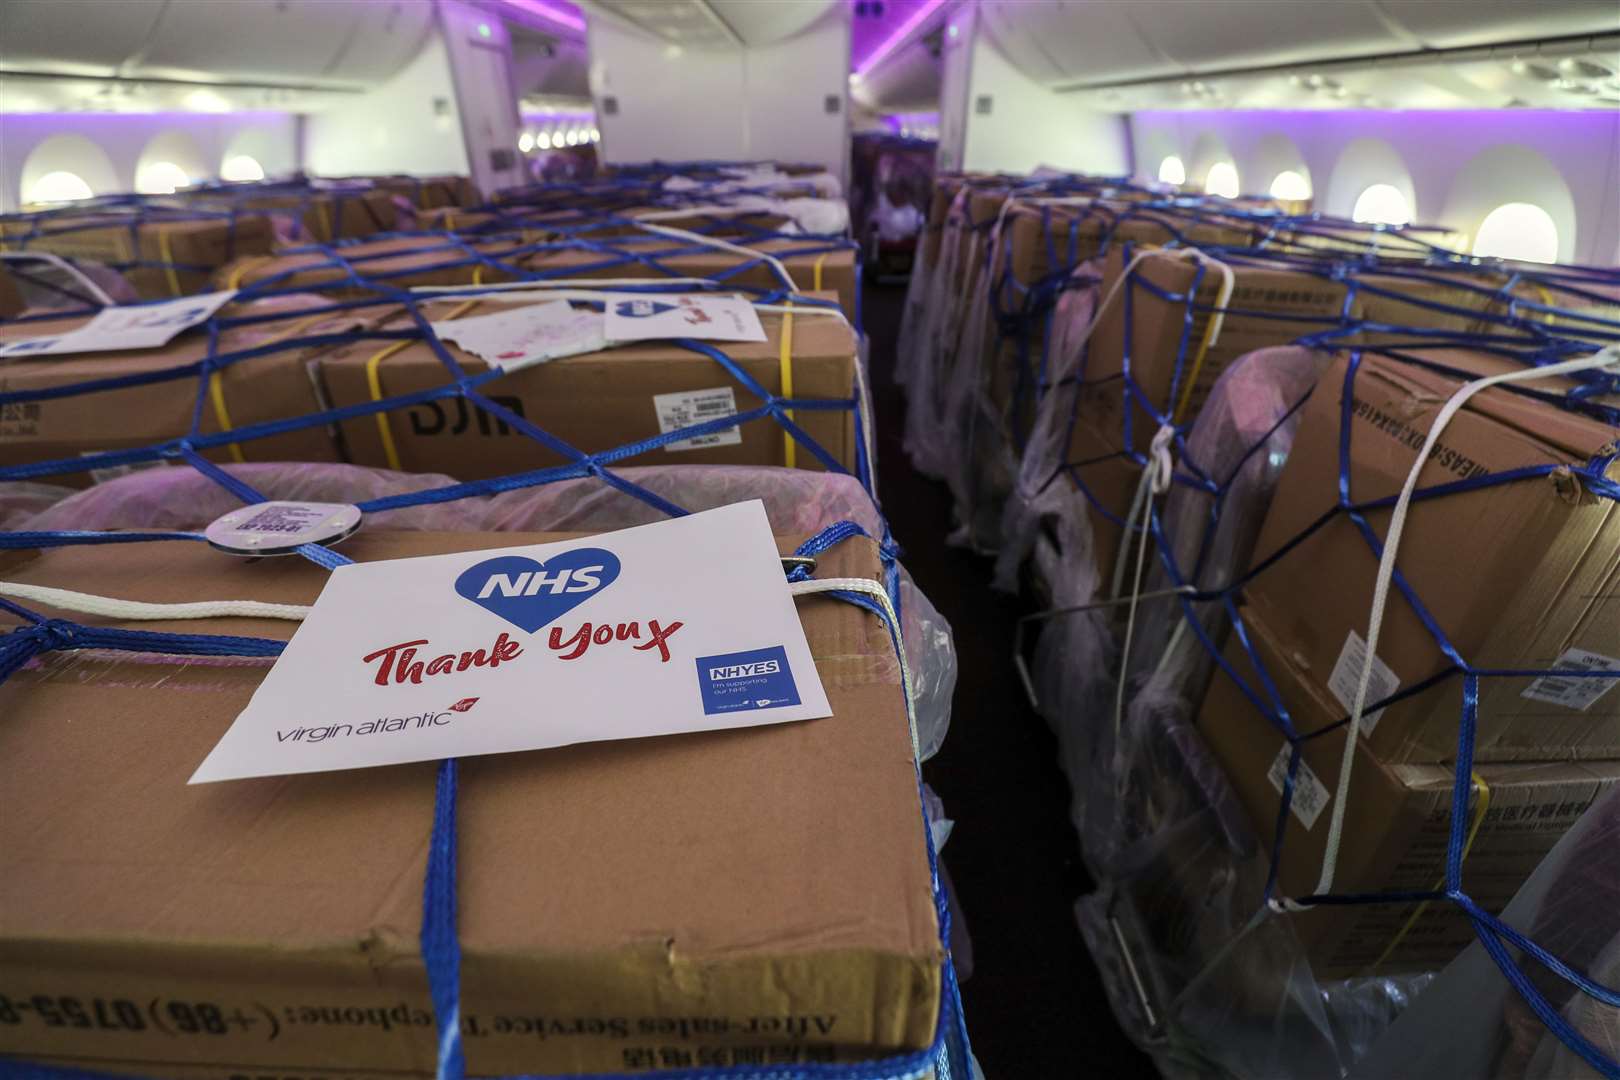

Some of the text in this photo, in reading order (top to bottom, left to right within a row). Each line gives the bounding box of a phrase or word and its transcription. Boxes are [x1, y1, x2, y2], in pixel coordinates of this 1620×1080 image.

[477, 566, 604, 599] NHS
[363, 632, 525, 686] Thank
[712, 661, 777, 679] NHYES
[726, 678, 768, 688] supporting
[277, 711, 452, 743] virgin atlantic
[495, 1013, 629, 1039] Service
[636, 1014, 836, 1040] After-sales
